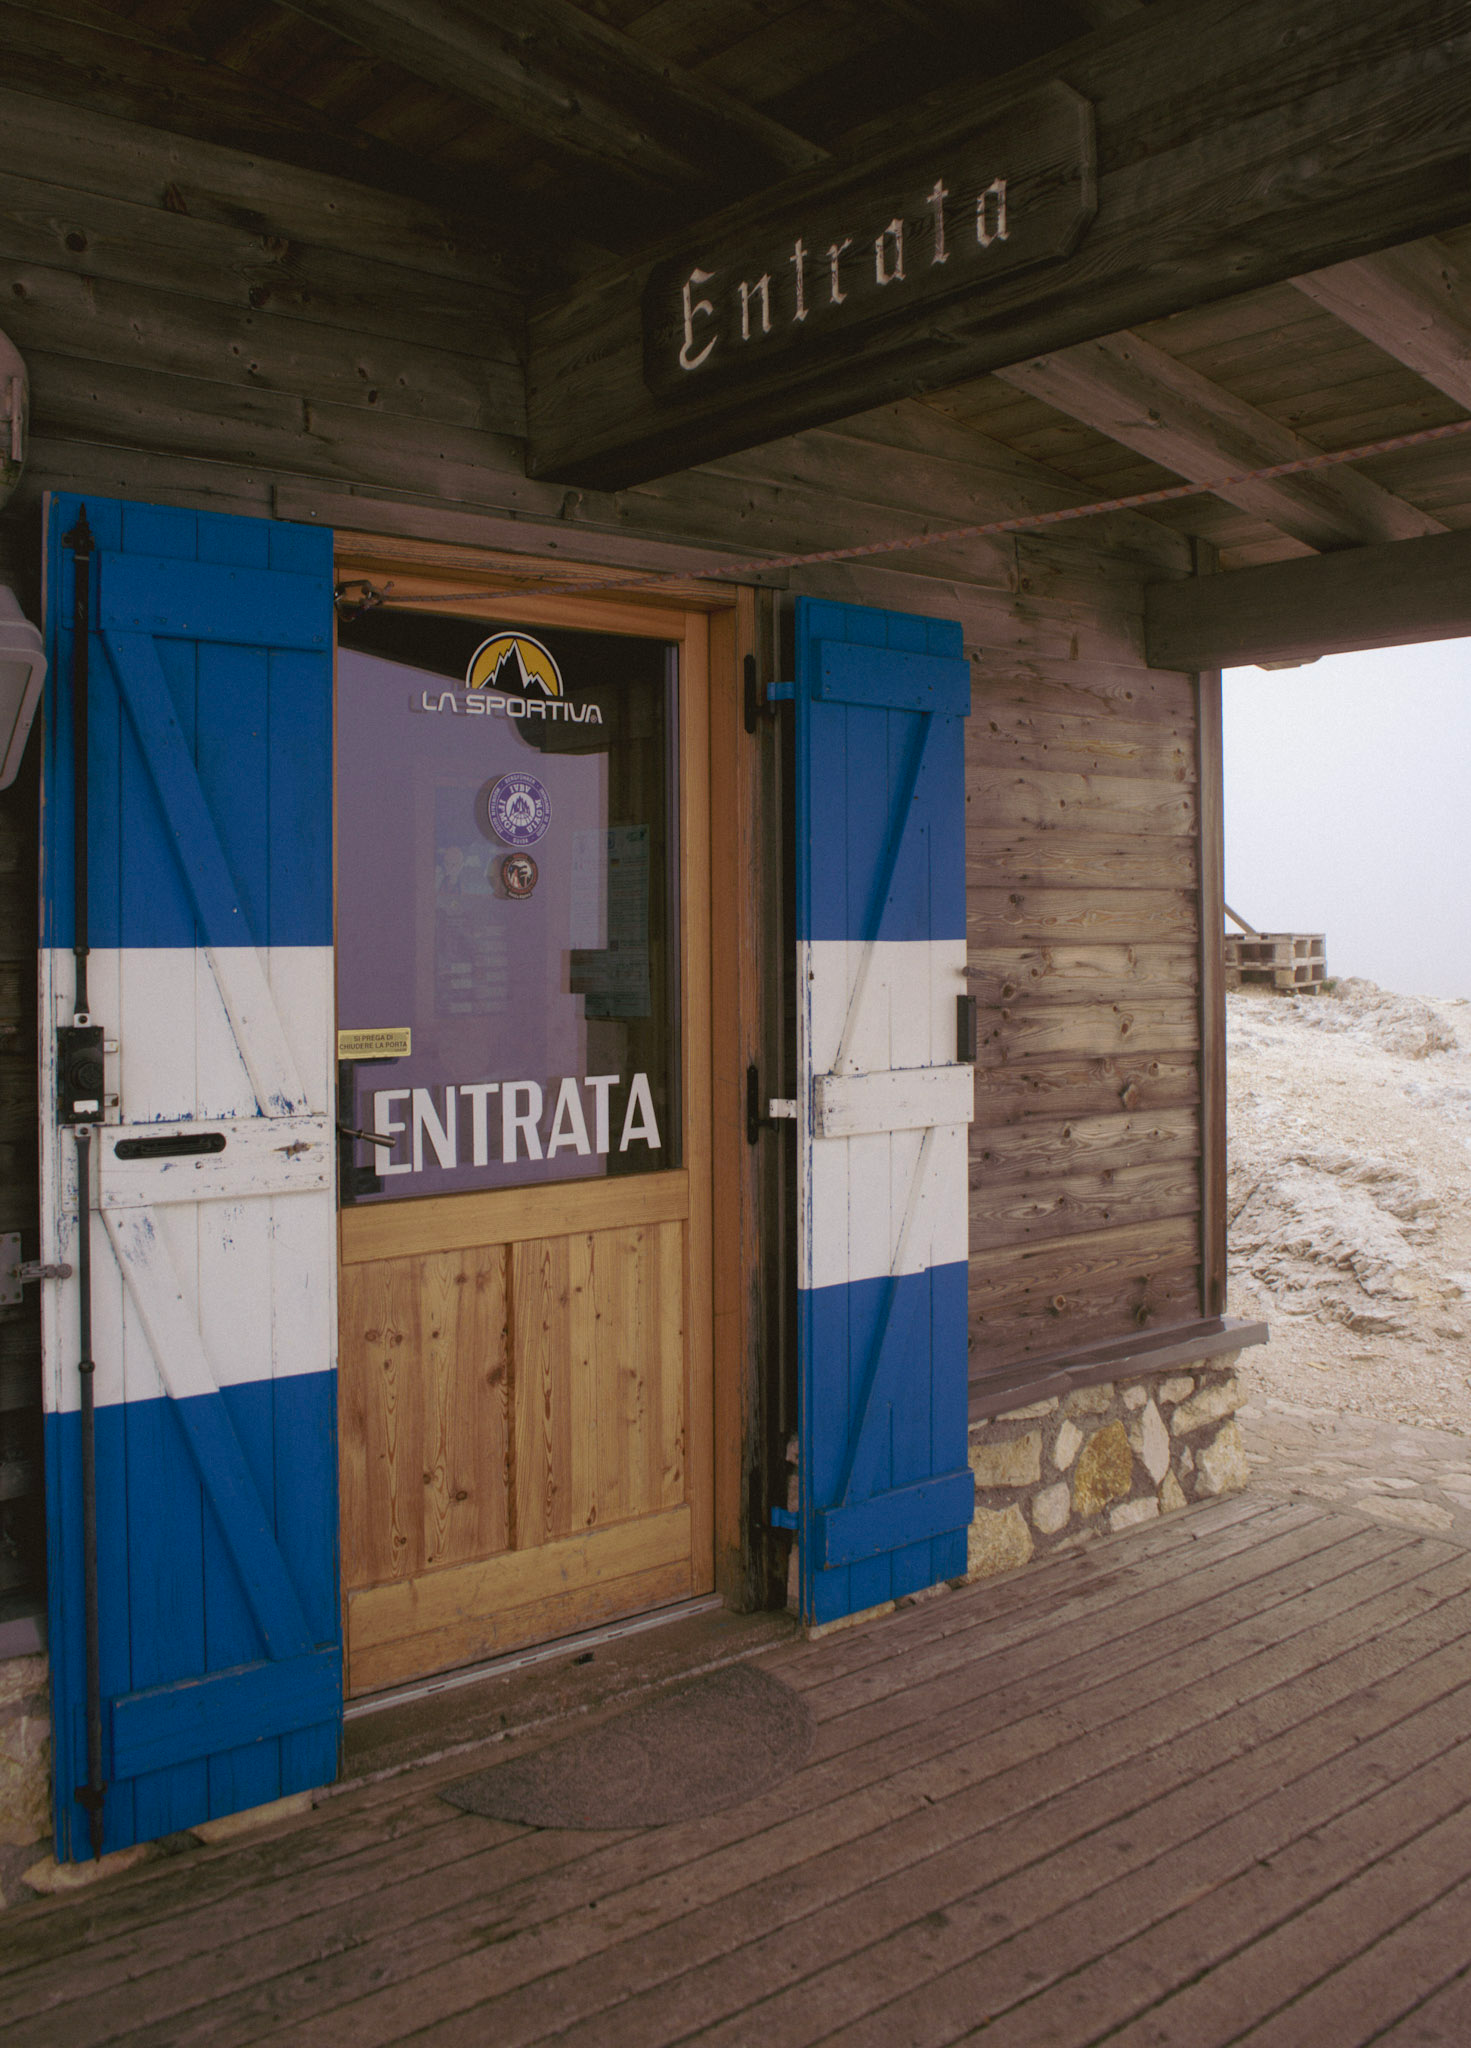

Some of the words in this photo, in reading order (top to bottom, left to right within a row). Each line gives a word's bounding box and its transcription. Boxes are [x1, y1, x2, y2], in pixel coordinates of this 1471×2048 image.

[679, 178, 1010, 370] Entrata
[422, 691, 458, 713] LA
[465, 694, 603, 725] SPORTIVA
[509, 784, 531, 793] IVBV
[499, 800, 516, 834] IFMGA
[339, 1042, 374, 1050] CHIUDERE
[374, 1072, 661, 1176] ENTRATA
